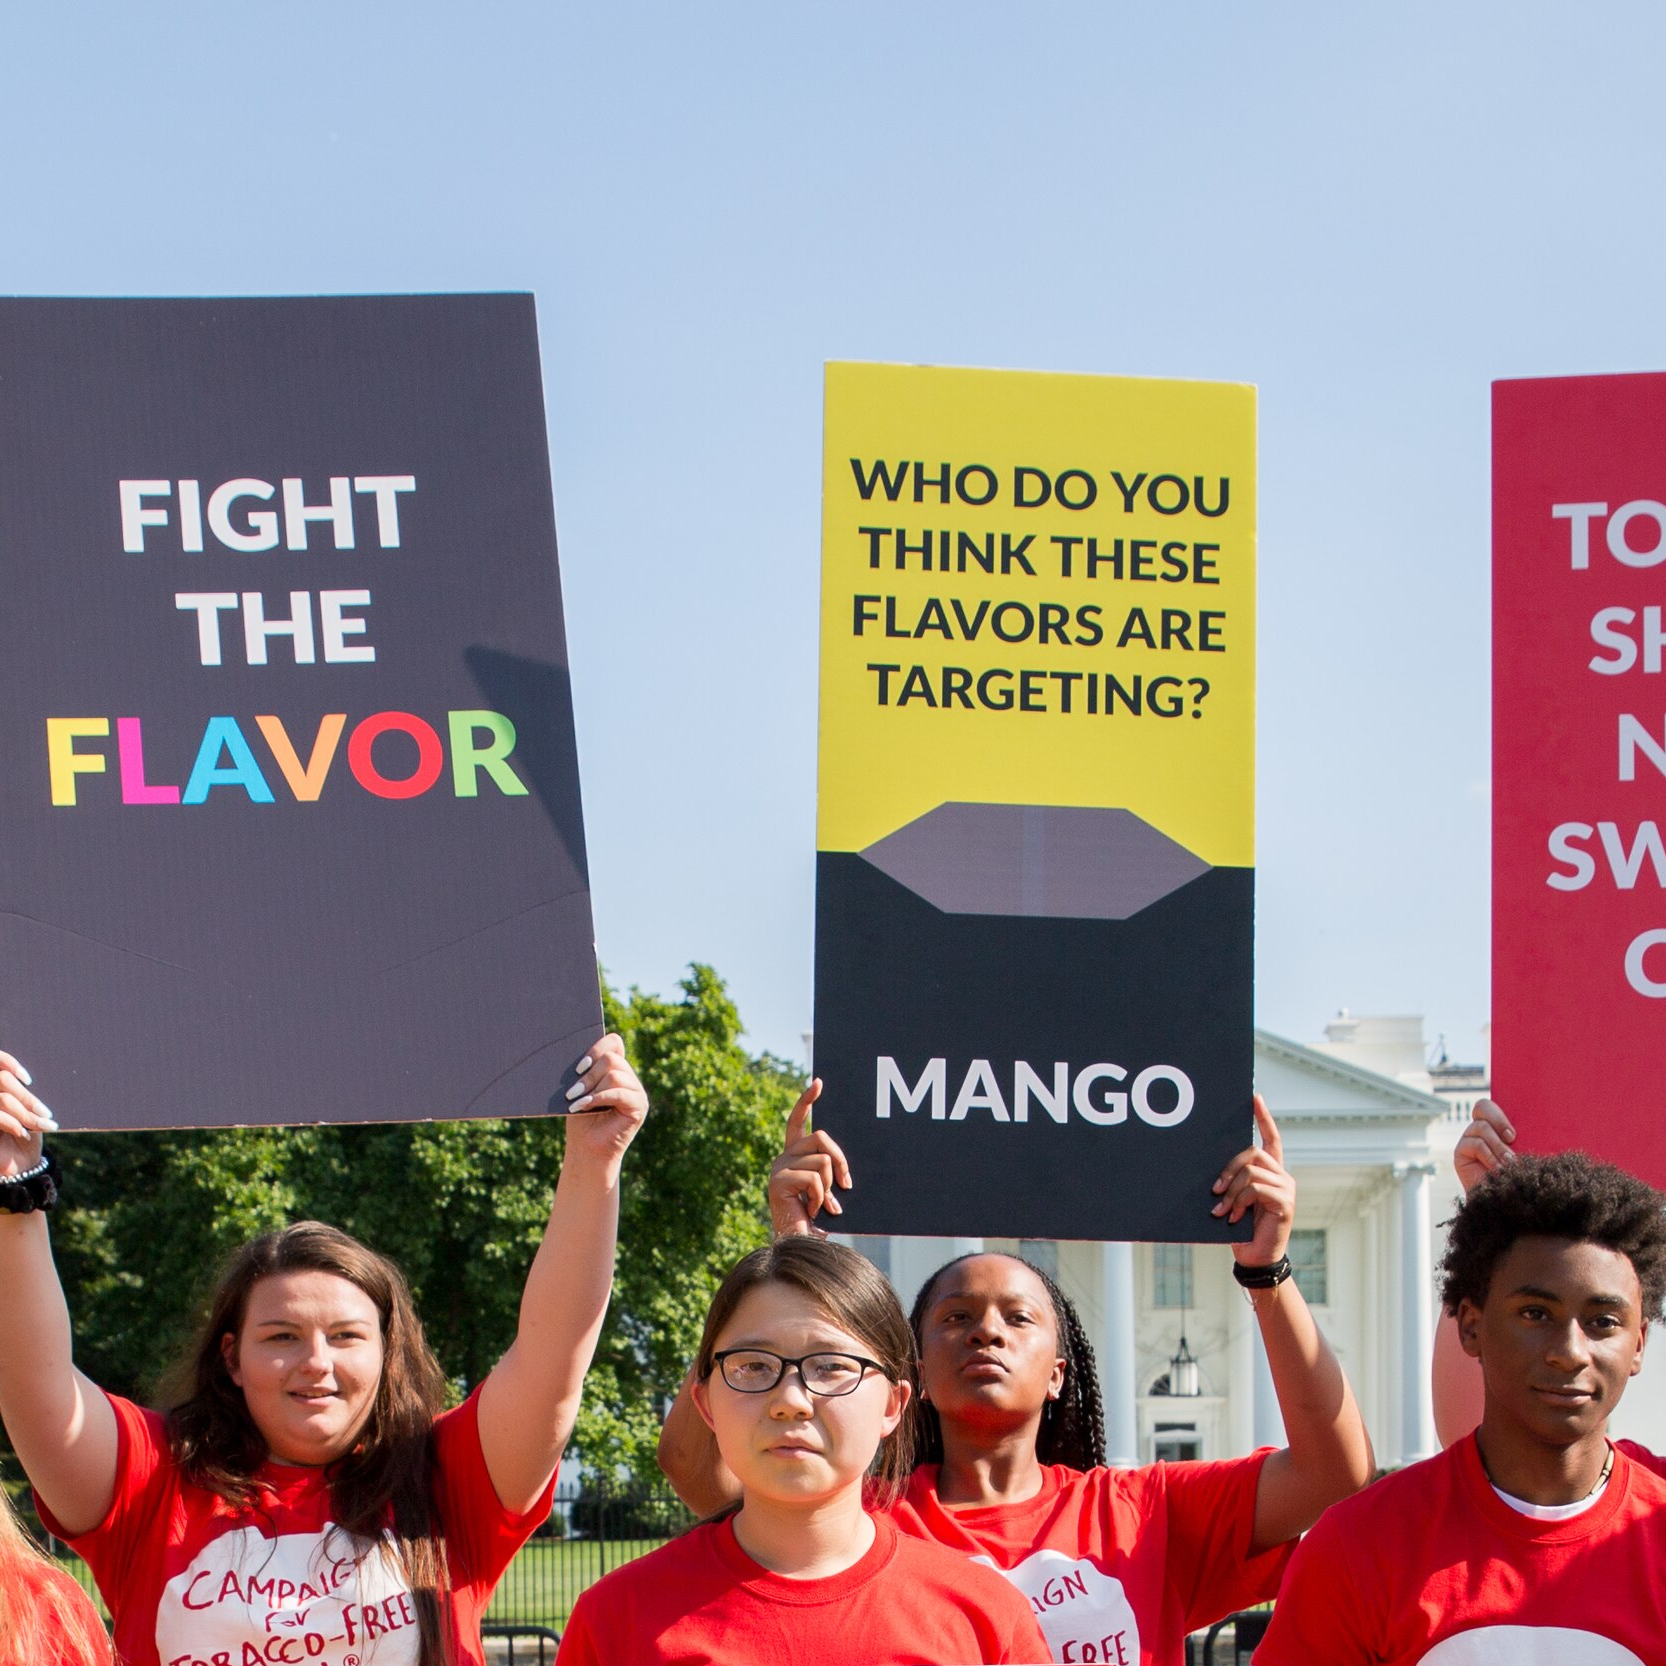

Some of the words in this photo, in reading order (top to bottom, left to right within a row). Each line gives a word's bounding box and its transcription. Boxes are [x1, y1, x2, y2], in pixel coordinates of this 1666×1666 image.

[120, 476, 415, 552] FIGHT
[850, 459, 998, 505] WHO
[1014, 467, 1097, 510] DO
[1111, 472, 1229, 517] YOU
[859, 527, 1037, 575] THINK
[1050, 536, 1220, 584] THESE
[175, 590, 375, 665] THE
[854, 595, 1103, 646] FLAVORS
[1117, 608, 1225, 652] ARE
[867, 664, 1210, 719] TARGETING?
[46, 709, 530, 807] FLAVOR
[877, 1056, 1194, 1127] MANGO
[182, 1556, 365, 1610] CAMPAIG
